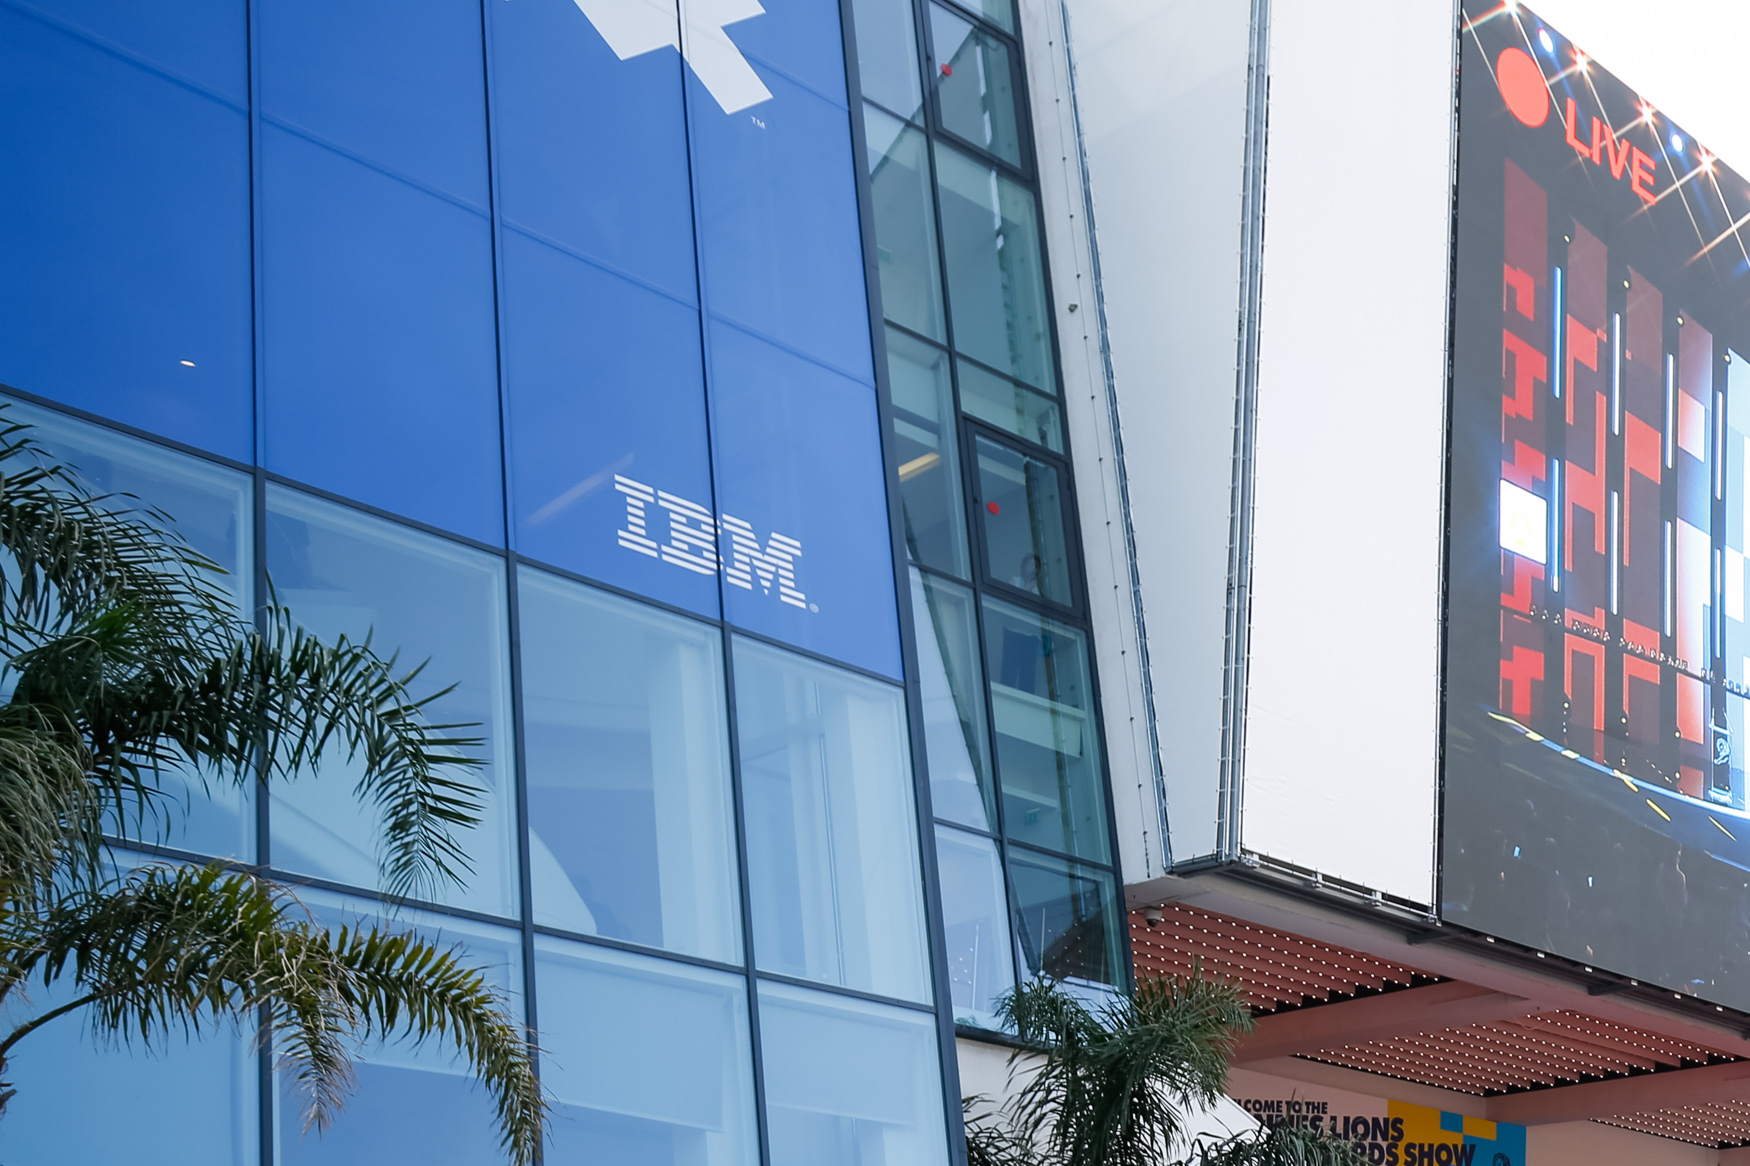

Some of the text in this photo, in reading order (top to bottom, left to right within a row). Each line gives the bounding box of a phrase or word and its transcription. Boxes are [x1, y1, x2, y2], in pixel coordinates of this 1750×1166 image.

[1566, 97, 1657, 206] LIVE
[614, 474, 807, 609] IBM
[1305, 1101, 1328, 1114] THE
[1330, 1115, 1404, 1142] LIONS
